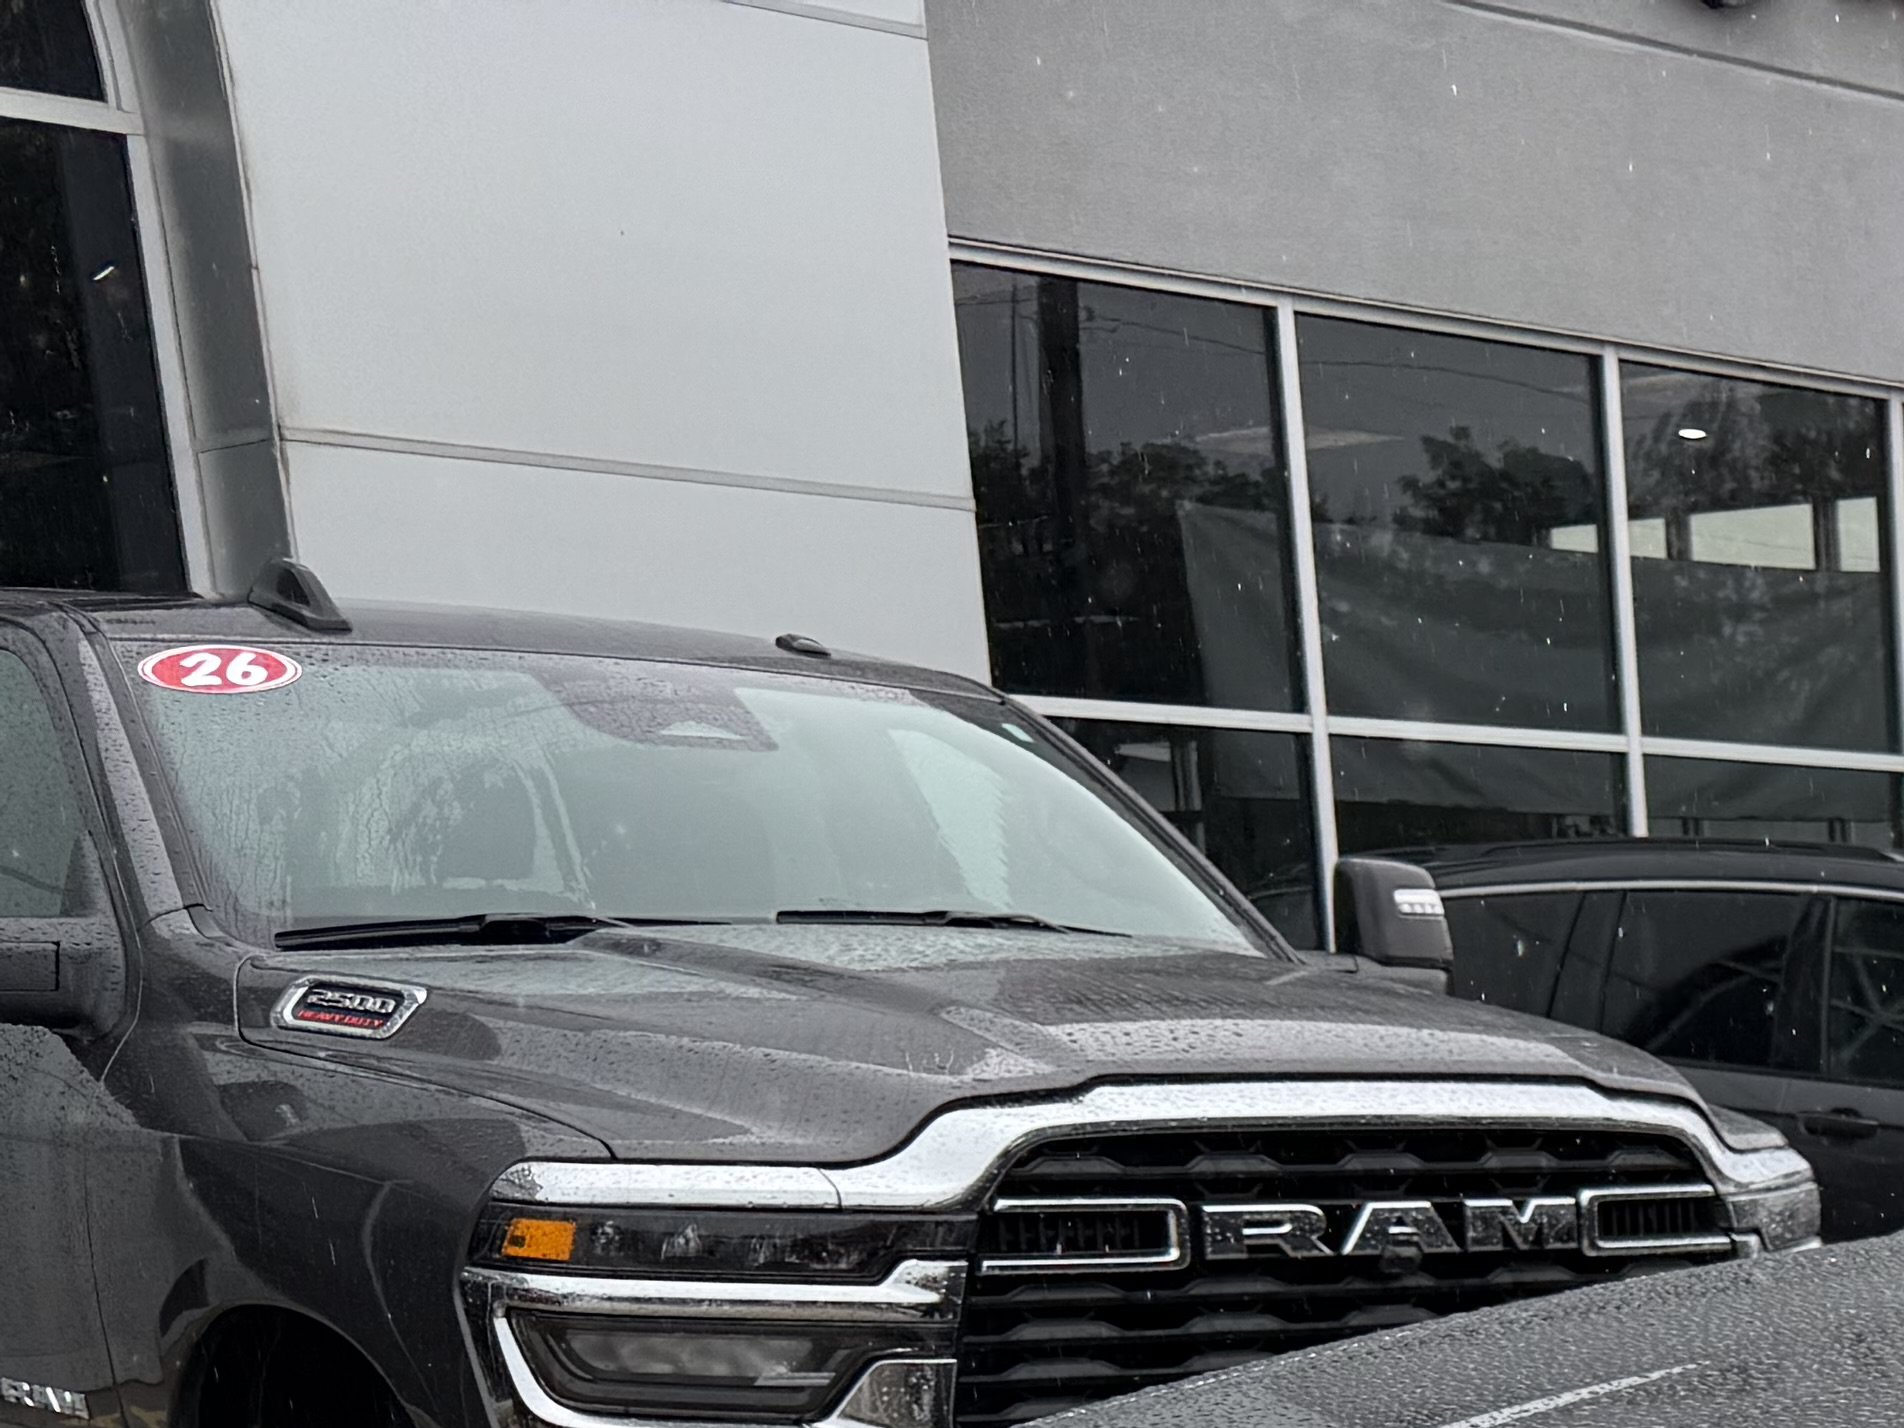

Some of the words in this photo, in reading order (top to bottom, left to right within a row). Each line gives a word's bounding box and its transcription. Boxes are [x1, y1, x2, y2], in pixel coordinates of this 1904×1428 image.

[180, 652, 268, 686] 26
[307, 989, 397, 1014] 2500
[297, 1010, 344, 1023] HEAVY
[344, 1015, 385, 1027] DUTY
[1202, 1198, 1578, 1261] RAM
